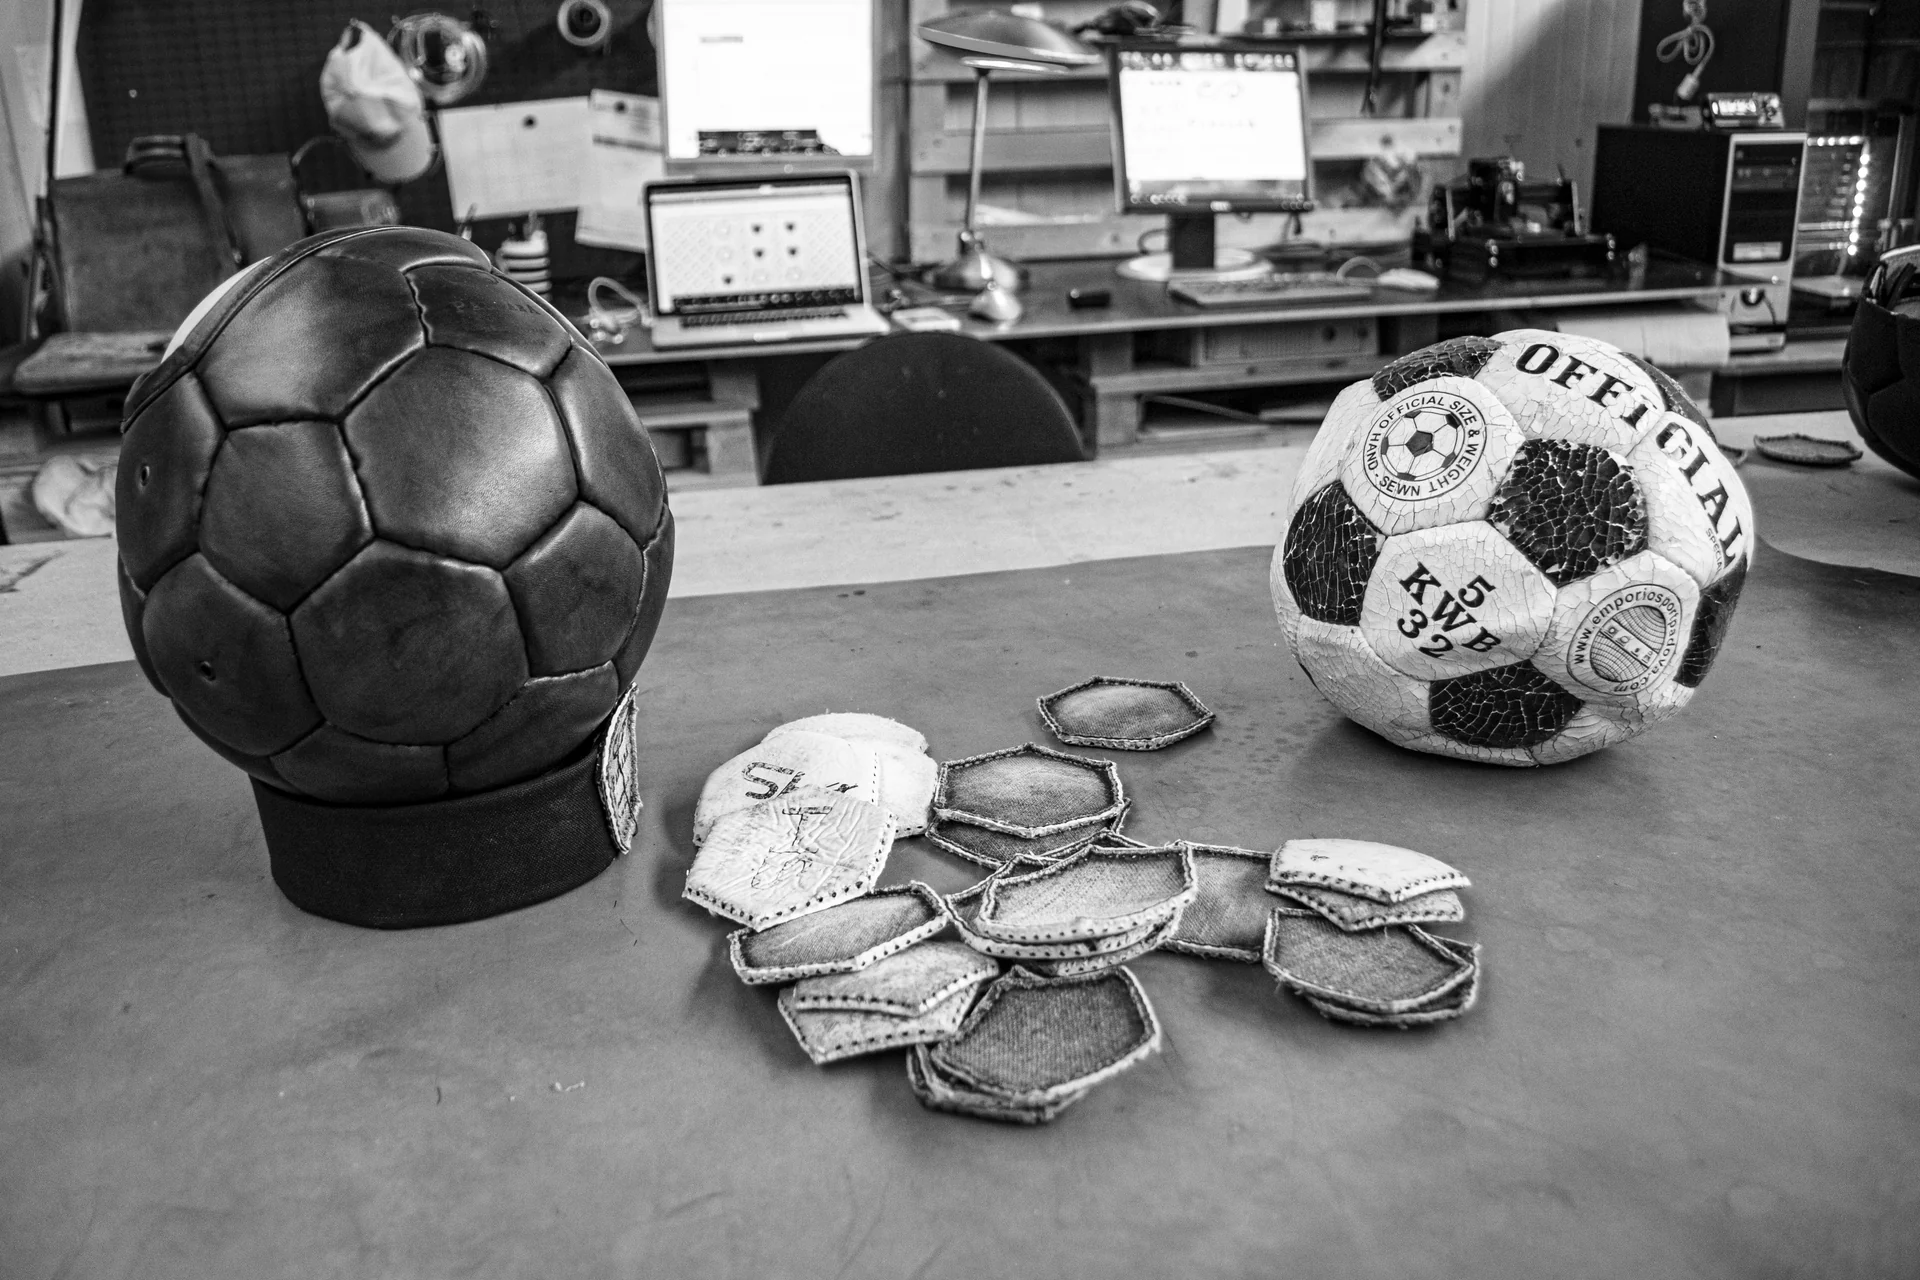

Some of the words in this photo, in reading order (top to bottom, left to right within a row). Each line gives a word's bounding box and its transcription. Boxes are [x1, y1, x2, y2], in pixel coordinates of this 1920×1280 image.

[1379, 395, 1446, 429] OFFICIAL
[1449, 400, 1478, 425] SIZE
[1468, 429, 1480, 438] &
[1366, 432, 1381, 471] HAND
[1379, 475, 1421, 497] SEWN
[1428, 442, 1480, 493] WEIGHT
[1515, 343, 1744, 570] OFFICIAL
[1398, 561, 1501, 653] KWB
[1457, 574, 1497, 608] 5
[1397, 608, 1454, 659] 32
[1573, 587, 1680, 693] www.emporiosportpadova.com
